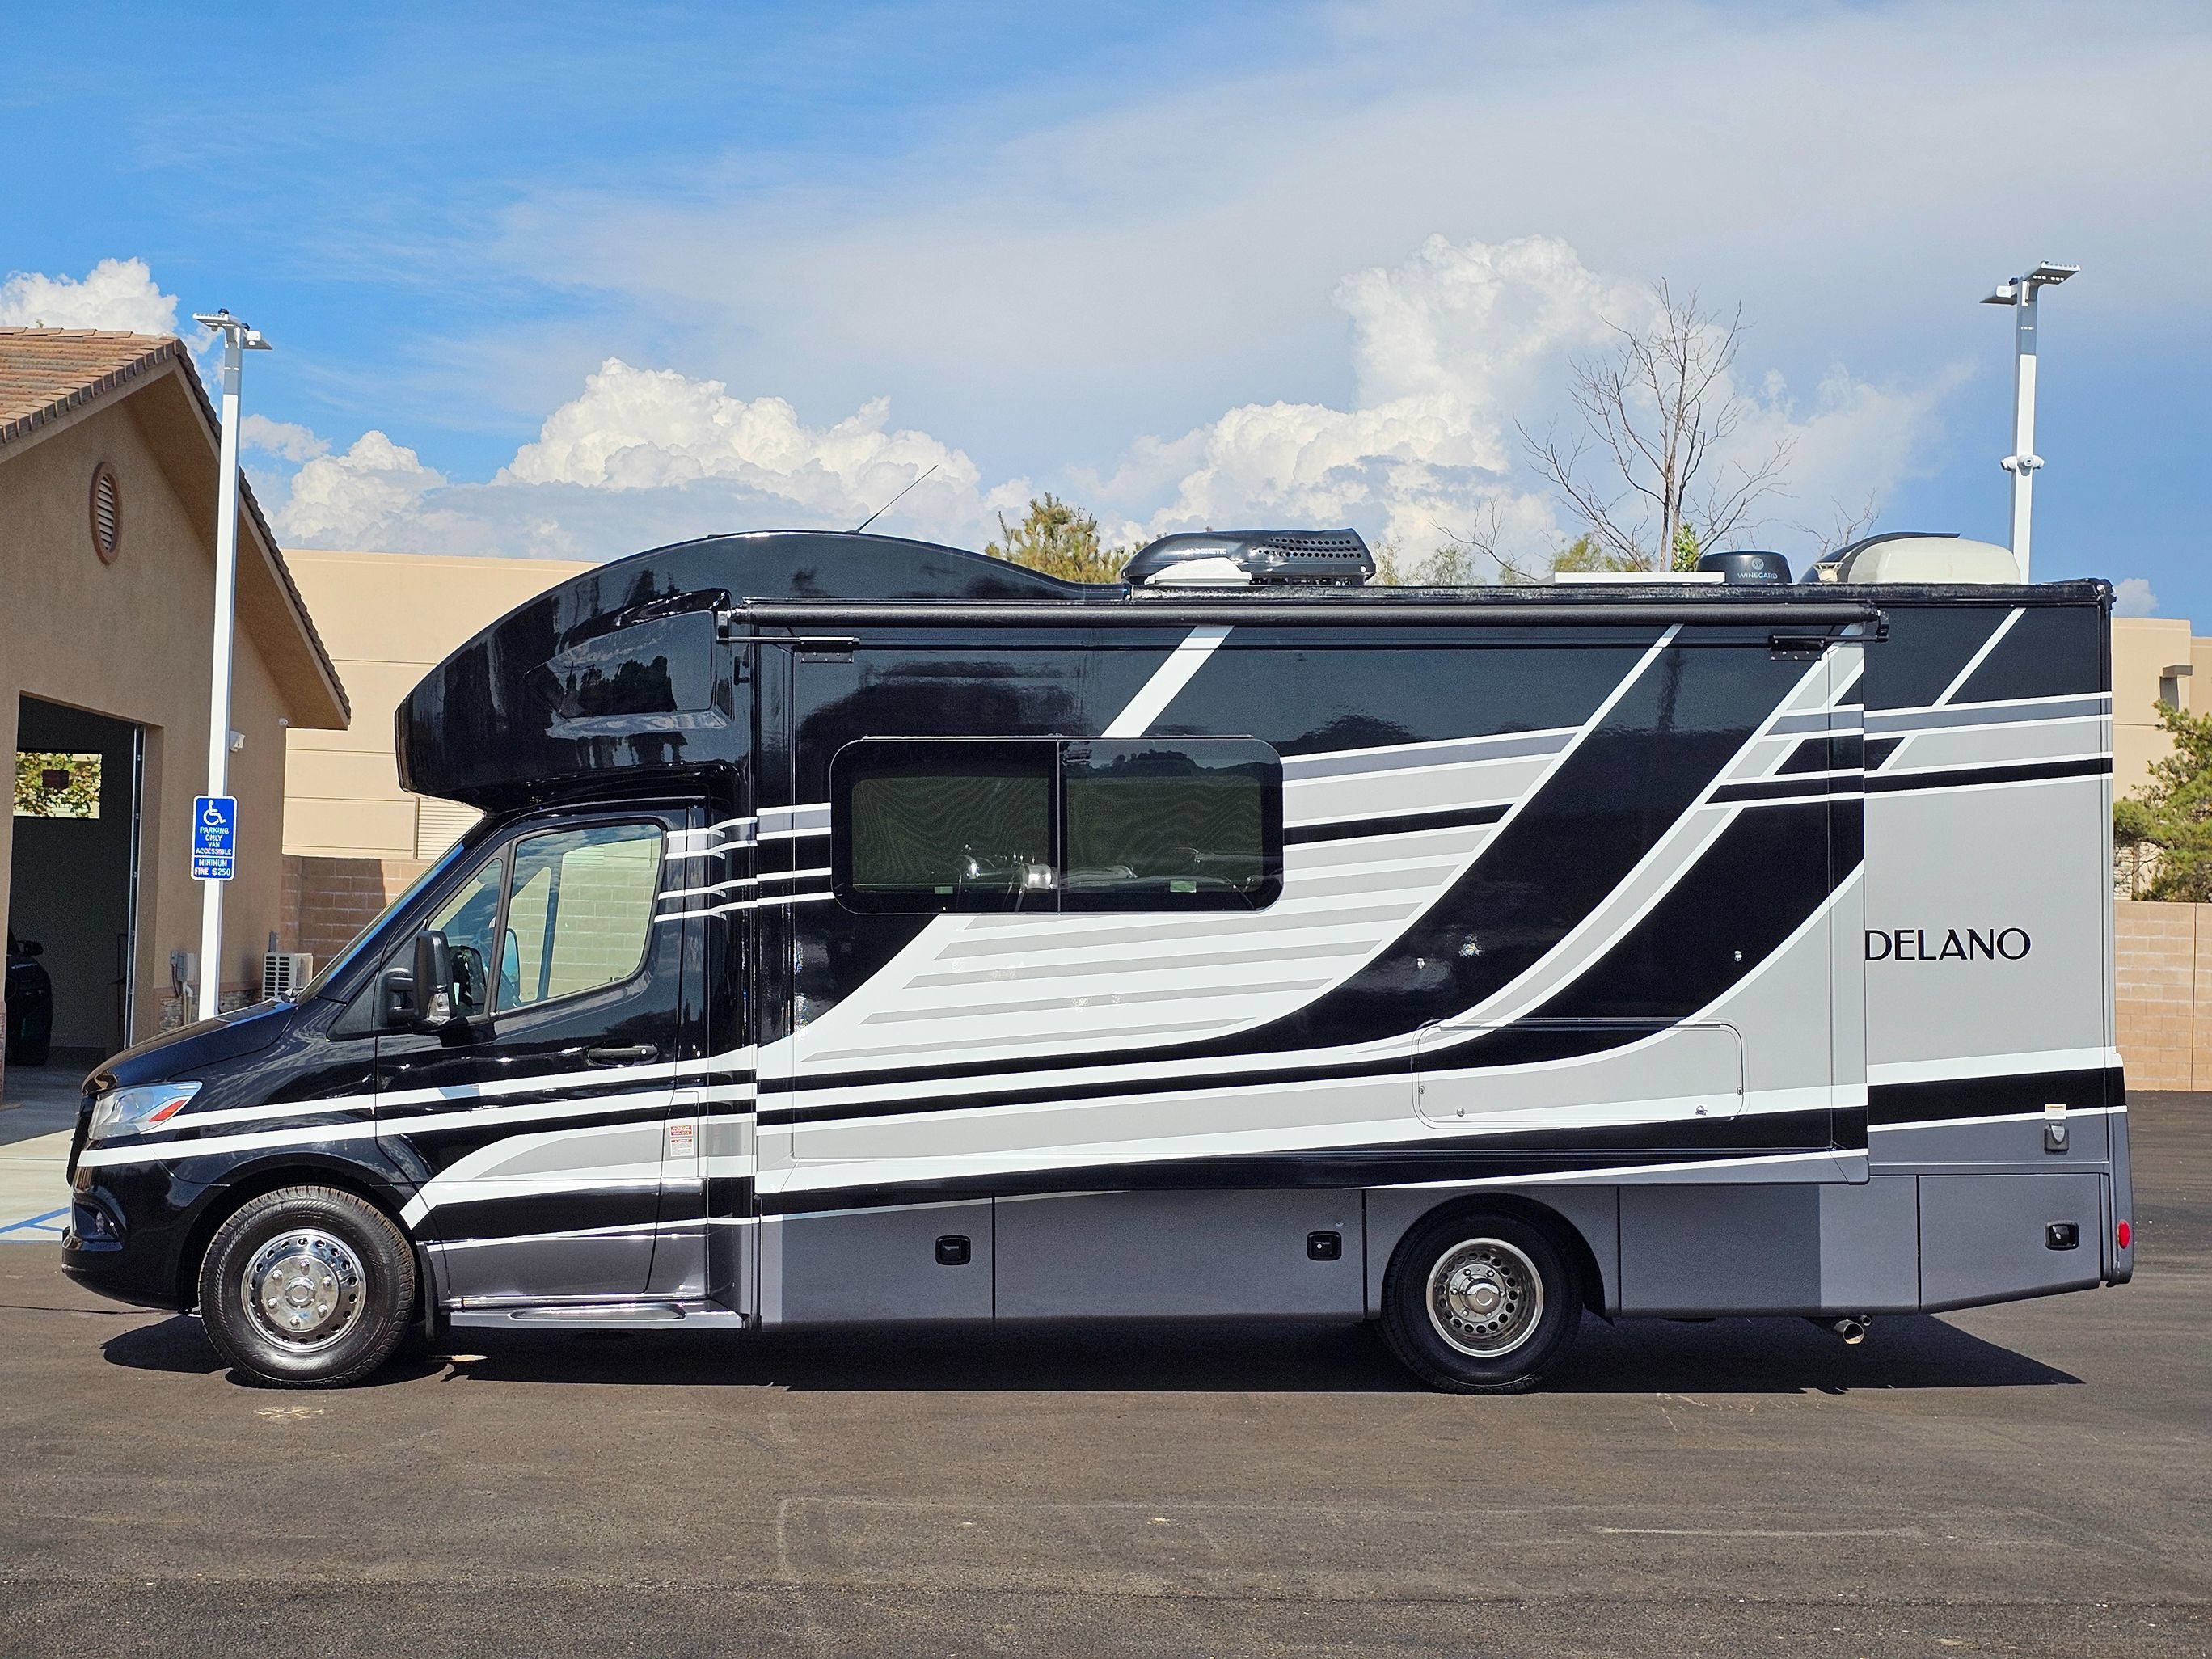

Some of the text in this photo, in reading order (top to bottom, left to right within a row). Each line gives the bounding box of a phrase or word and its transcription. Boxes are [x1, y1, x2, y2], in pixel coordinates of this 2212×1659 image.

[1737, 572, 1778, 580] WINEGARD
[199, 826, 230, 834] PARKING
[198, 859, 227, 867] MINIMUM
[194, 867, 231, 876] FINE $250
[1864, 927, 2031, 960] DELANO
